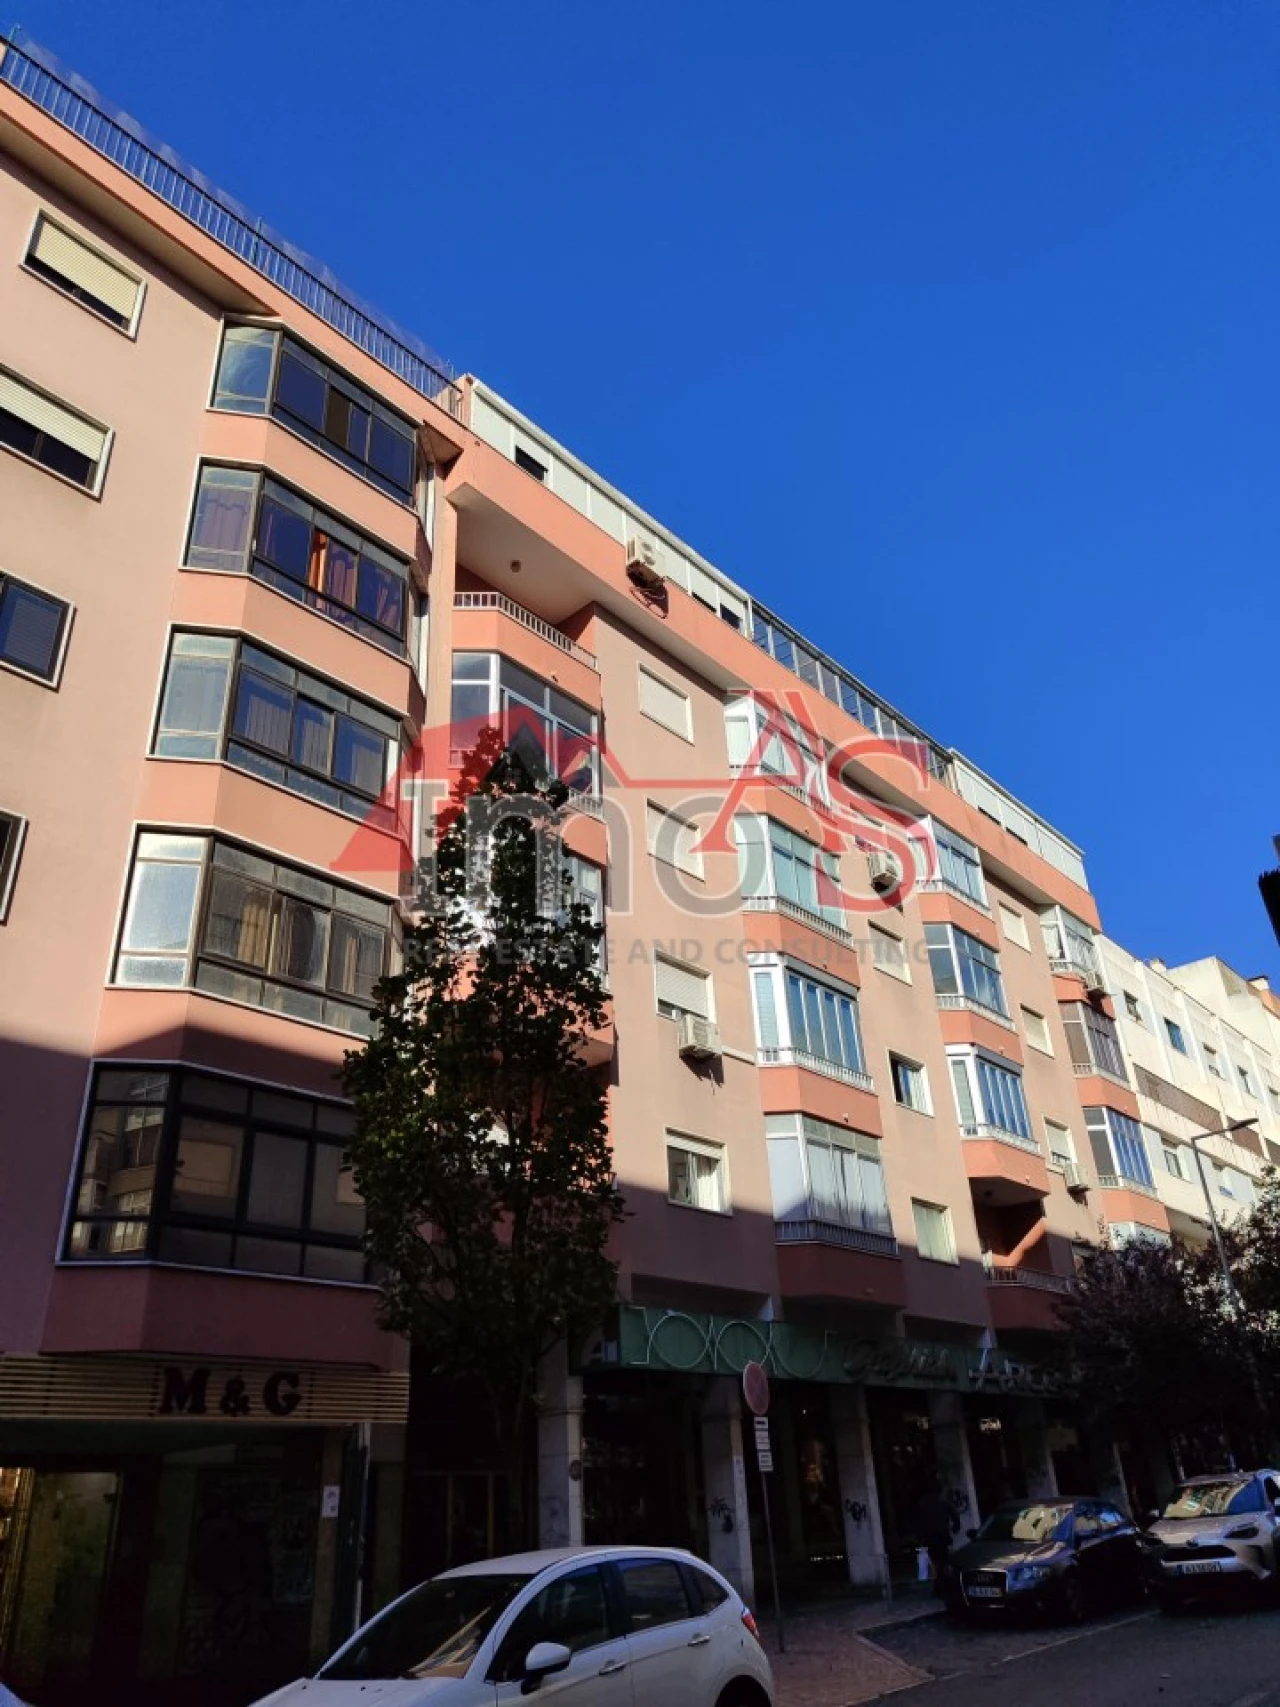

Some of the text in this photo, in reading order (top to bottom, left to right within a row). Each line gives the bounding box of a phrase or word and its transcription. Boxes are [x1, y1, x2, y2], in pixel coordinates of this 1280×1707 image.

[160, 1367, 303, 1416] M & G
